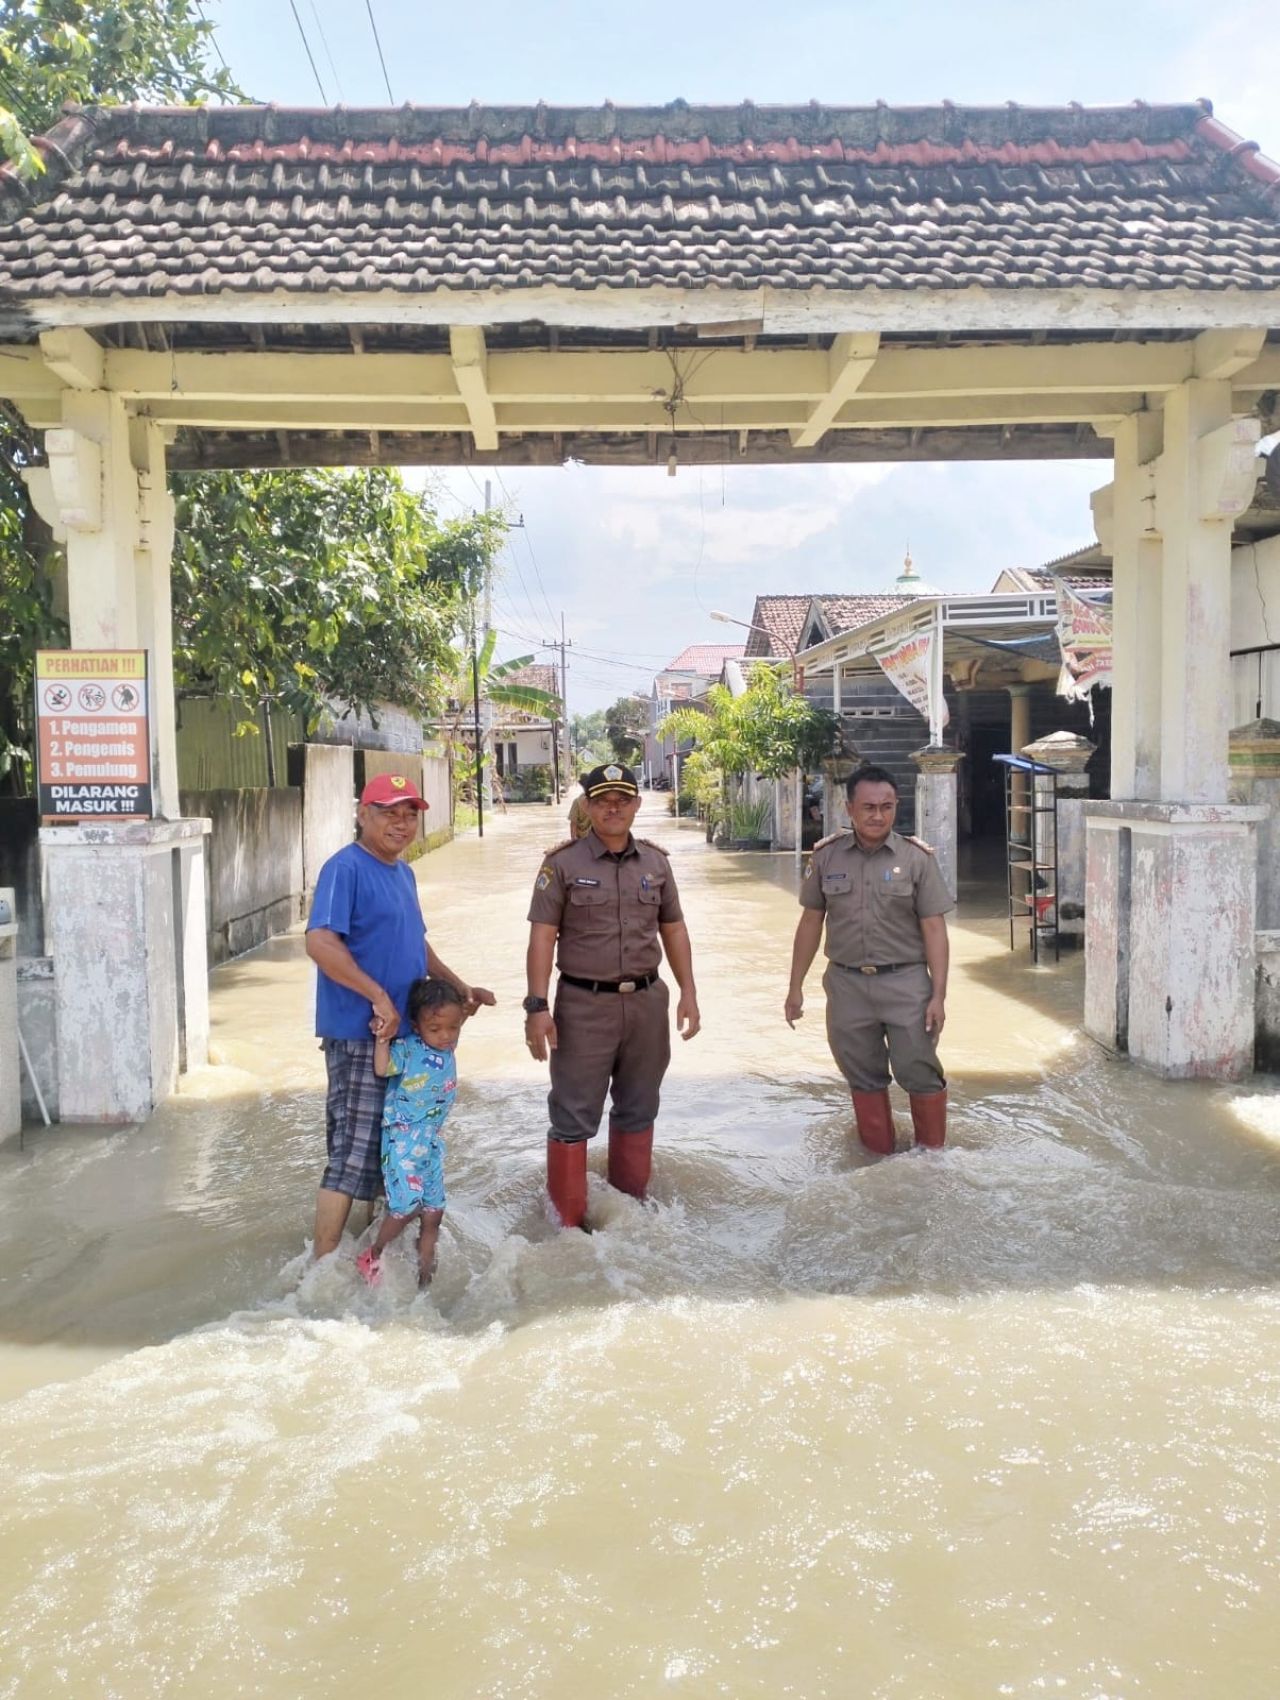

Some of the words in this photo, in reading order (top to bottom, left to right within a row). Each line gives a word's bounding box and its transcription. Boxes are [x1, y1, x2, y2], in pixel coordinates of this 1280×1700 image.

[46, 658, 118, 673] PERHATIAN
[122, 658, 136, 673] !!!
[49, 720, 60, 735] 1.
[62, 720, 137, 738] Pengamen
[50, 741, 62, 757] 2.
[65, 741, 135, 758] Pengemis
[50, 762, 64, 777] 3.
[66, 762, 137, 778] Pemulung
[51, 786, 139, 799] DILARANG
[56, 800, 118, 812] MASUK
[121, 800, 135, 812] !!!
